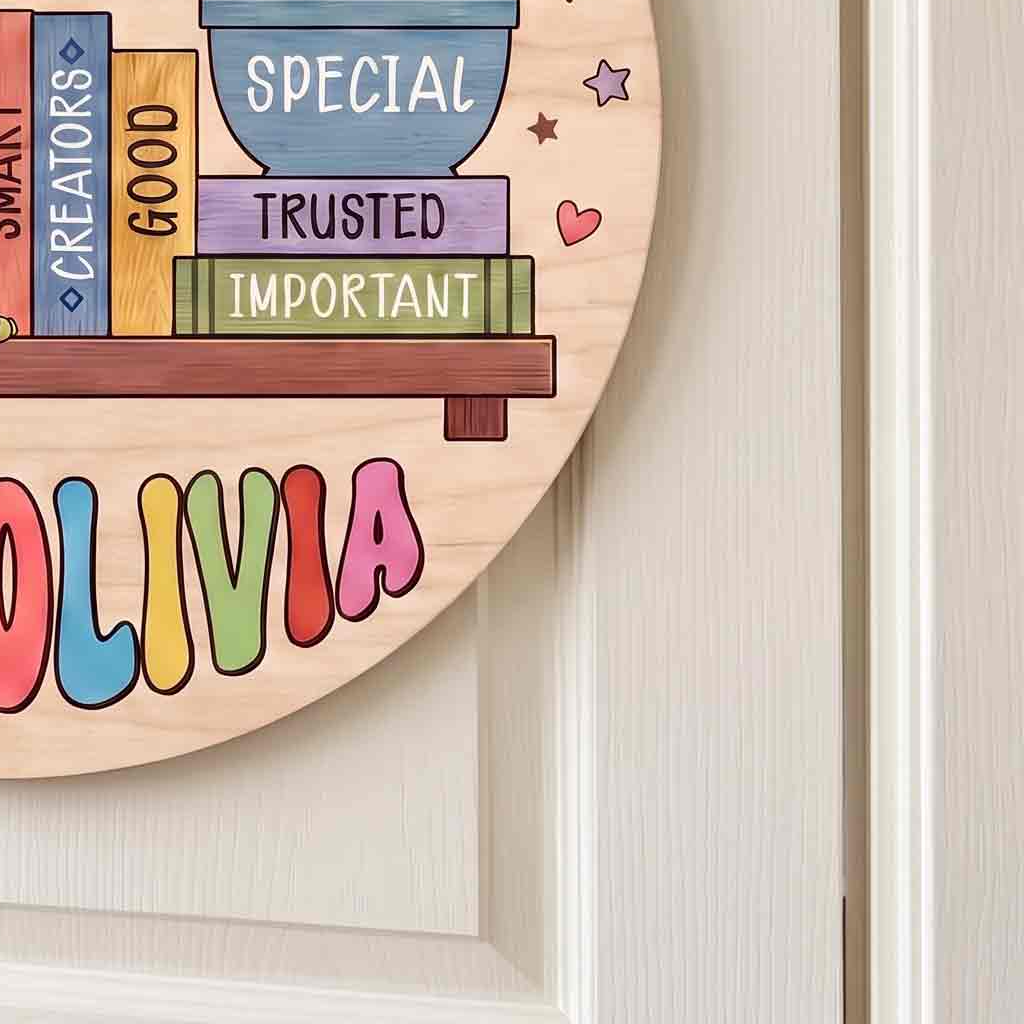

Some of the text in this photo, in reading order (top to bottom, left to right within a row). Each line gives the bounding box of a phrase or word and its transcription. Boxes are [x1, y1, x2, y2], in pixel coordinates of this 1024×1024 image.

[246, 54, 475, 114] SPECIAL
[50, 68, 94, 280] CREATORS
[126, 104, 178, 237] GOOD
[253, 192, 446, 240] TRUSTED
[228, 272, 478, 320] IMPORTANT
